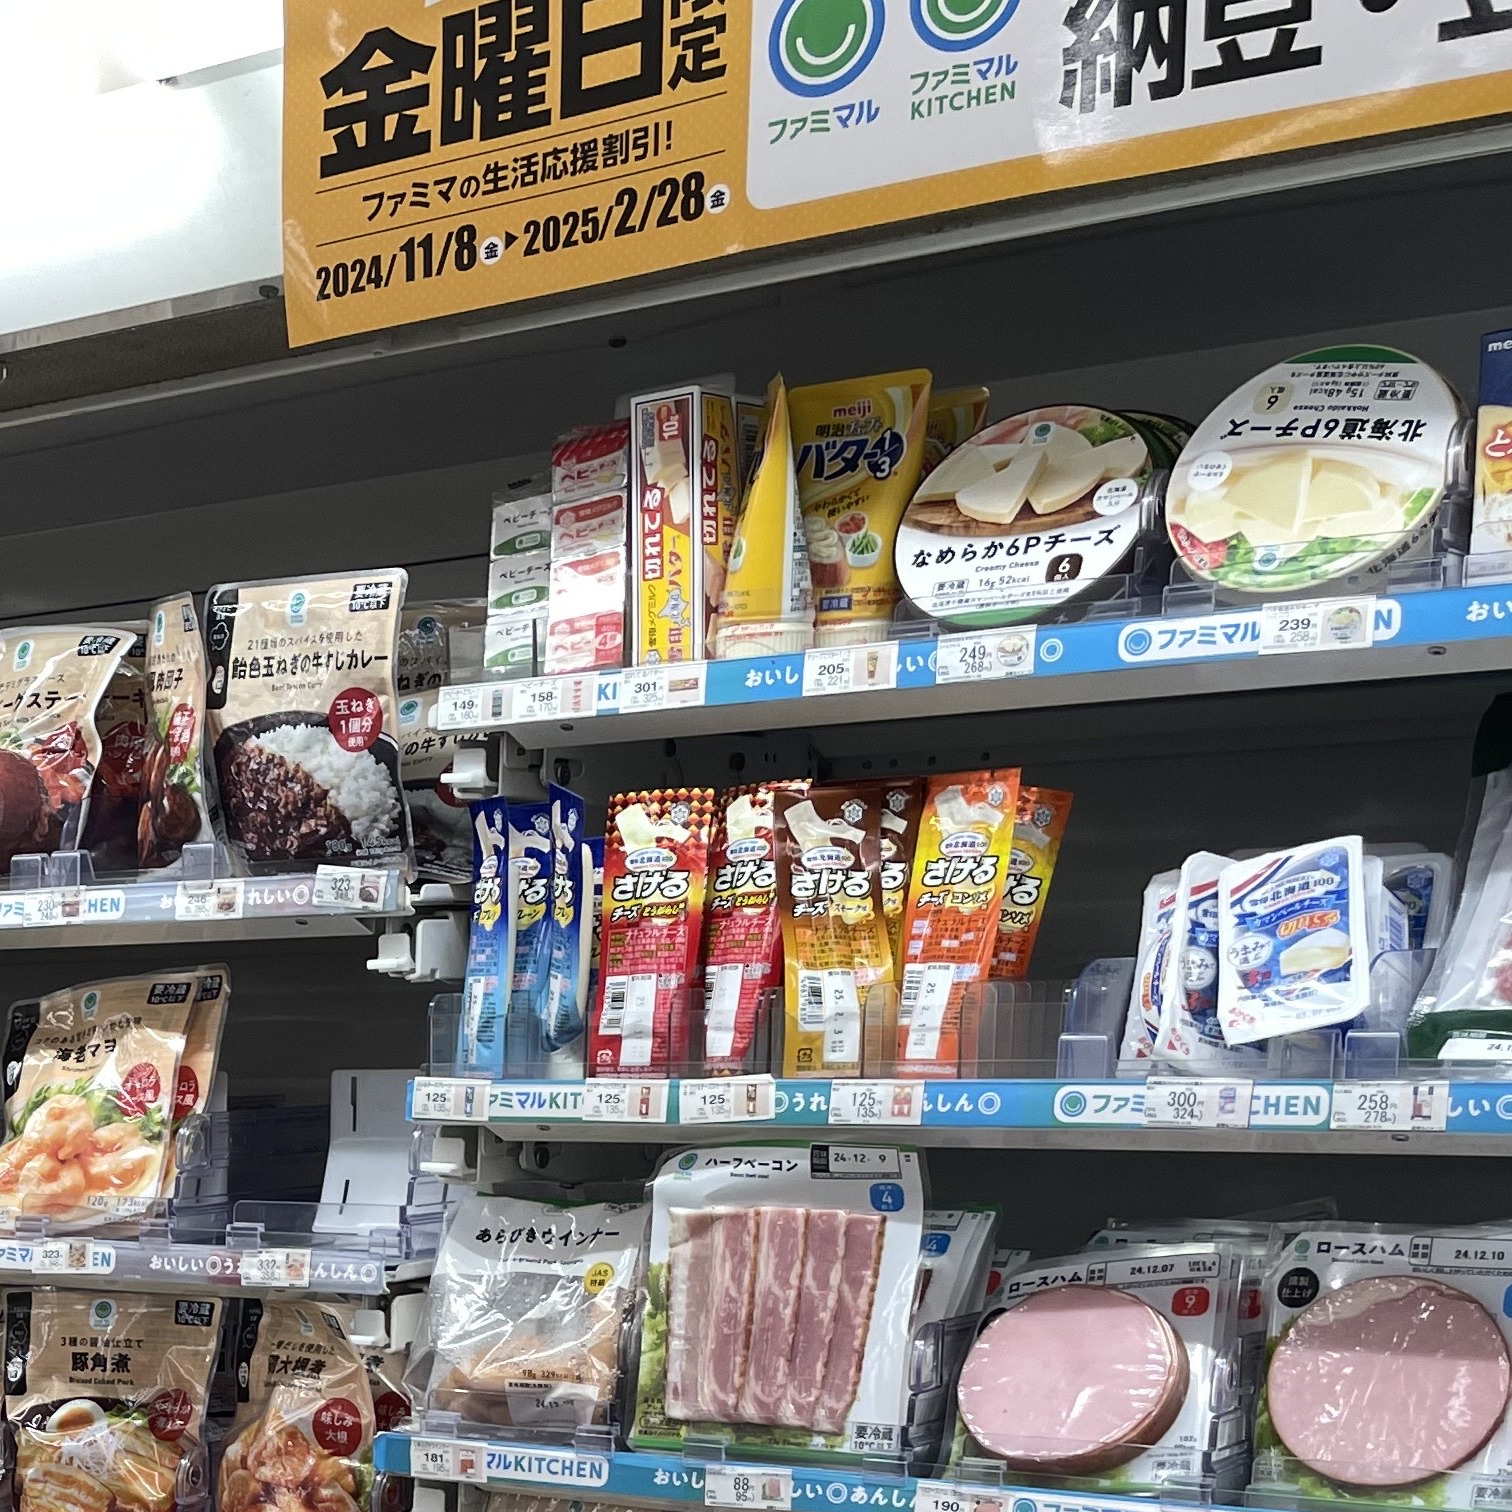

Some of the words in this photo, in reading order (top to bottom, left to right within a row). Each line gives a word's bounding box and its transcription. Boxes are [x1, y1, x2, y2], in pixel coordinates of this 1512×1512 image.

[909, 51, 1020, 97] ファミマル
[319, 0, 663, 179] 金曜日
[909, 80, 1017, 122] KITCHEN
[766, 97, 881, 146] ファミマル
[362, 120, 674, 222] ファミマの生活応援割引!
[315, 223, 477, 302] 2024/11/8
[523, 170, 706, 257] 2025/2/28
[832, 400, 872, 420] meiji
[1220, 416, 1429, 442] 北海道6Pチーズ
[912, 525, 1121, 568] なめらか6Pチーズ
[1058, 557, 1070, 574] 6
[334, 697, 378, 718] 玉ねぎ
[339, 718, 374, 734] 1個分
[705, 1155, 798, 1174] ハーフベーコン
[880, 1189, 893, 1207] 4
[1317, 1241, 1405, 1258] ロースハム
[1454, 1249, 1506, 1261] 24.12.10
[1007, 1270, 1083, 1294] ロースハム
[71, 1351, 131, 1374] 豚角煮
[854, 1425, 894, 1442] 要冷蔵
